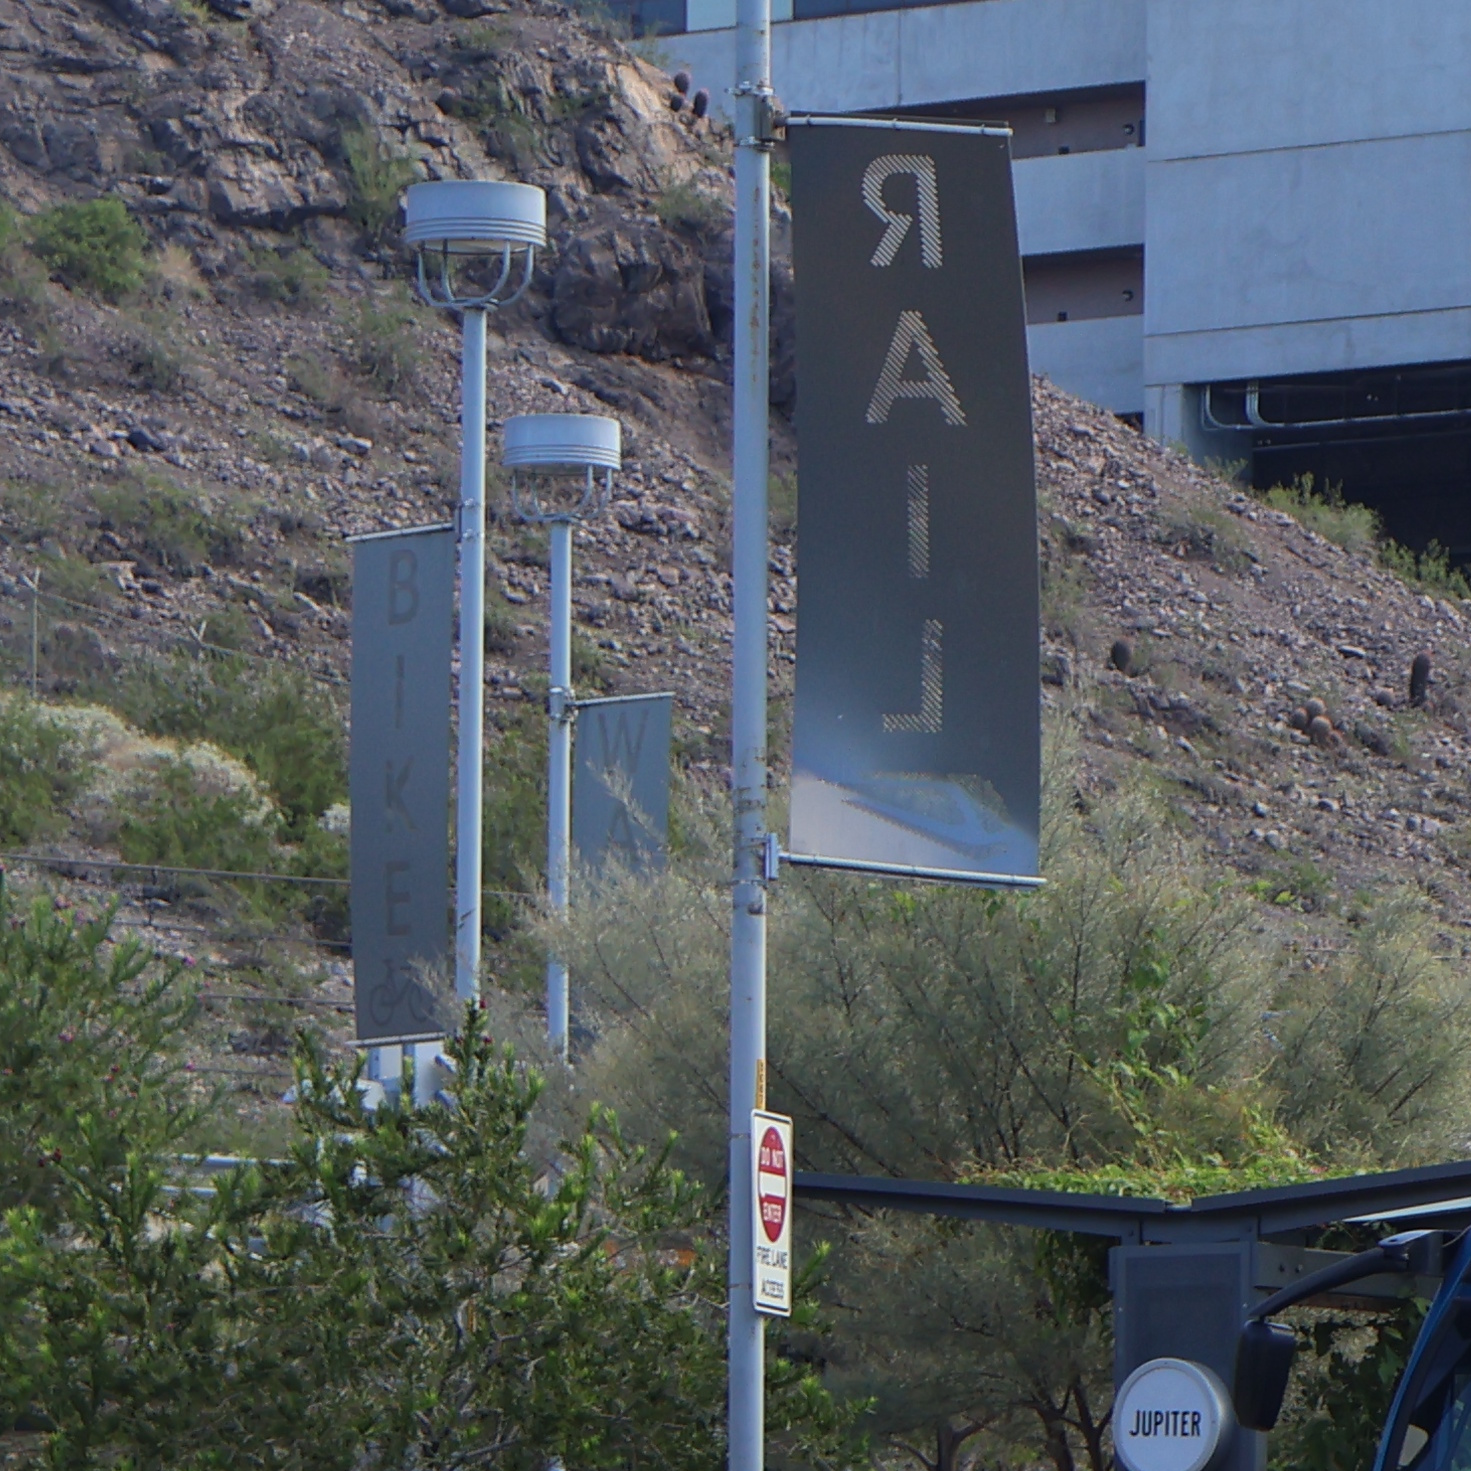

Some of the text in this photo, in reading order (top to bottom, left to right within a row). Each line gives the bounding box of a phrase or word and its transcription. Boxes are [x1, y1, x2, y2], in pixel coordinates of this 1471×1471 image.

[384, 548, 421, 937] BIKE
[760, 1146, 785, 1168] DO NOT
[762, 1202, 783, 1224] ENTER
[757, 1245, 788, 1270] FIRE LANE
[1129, 1410, 1202, 1437] JUPITER
